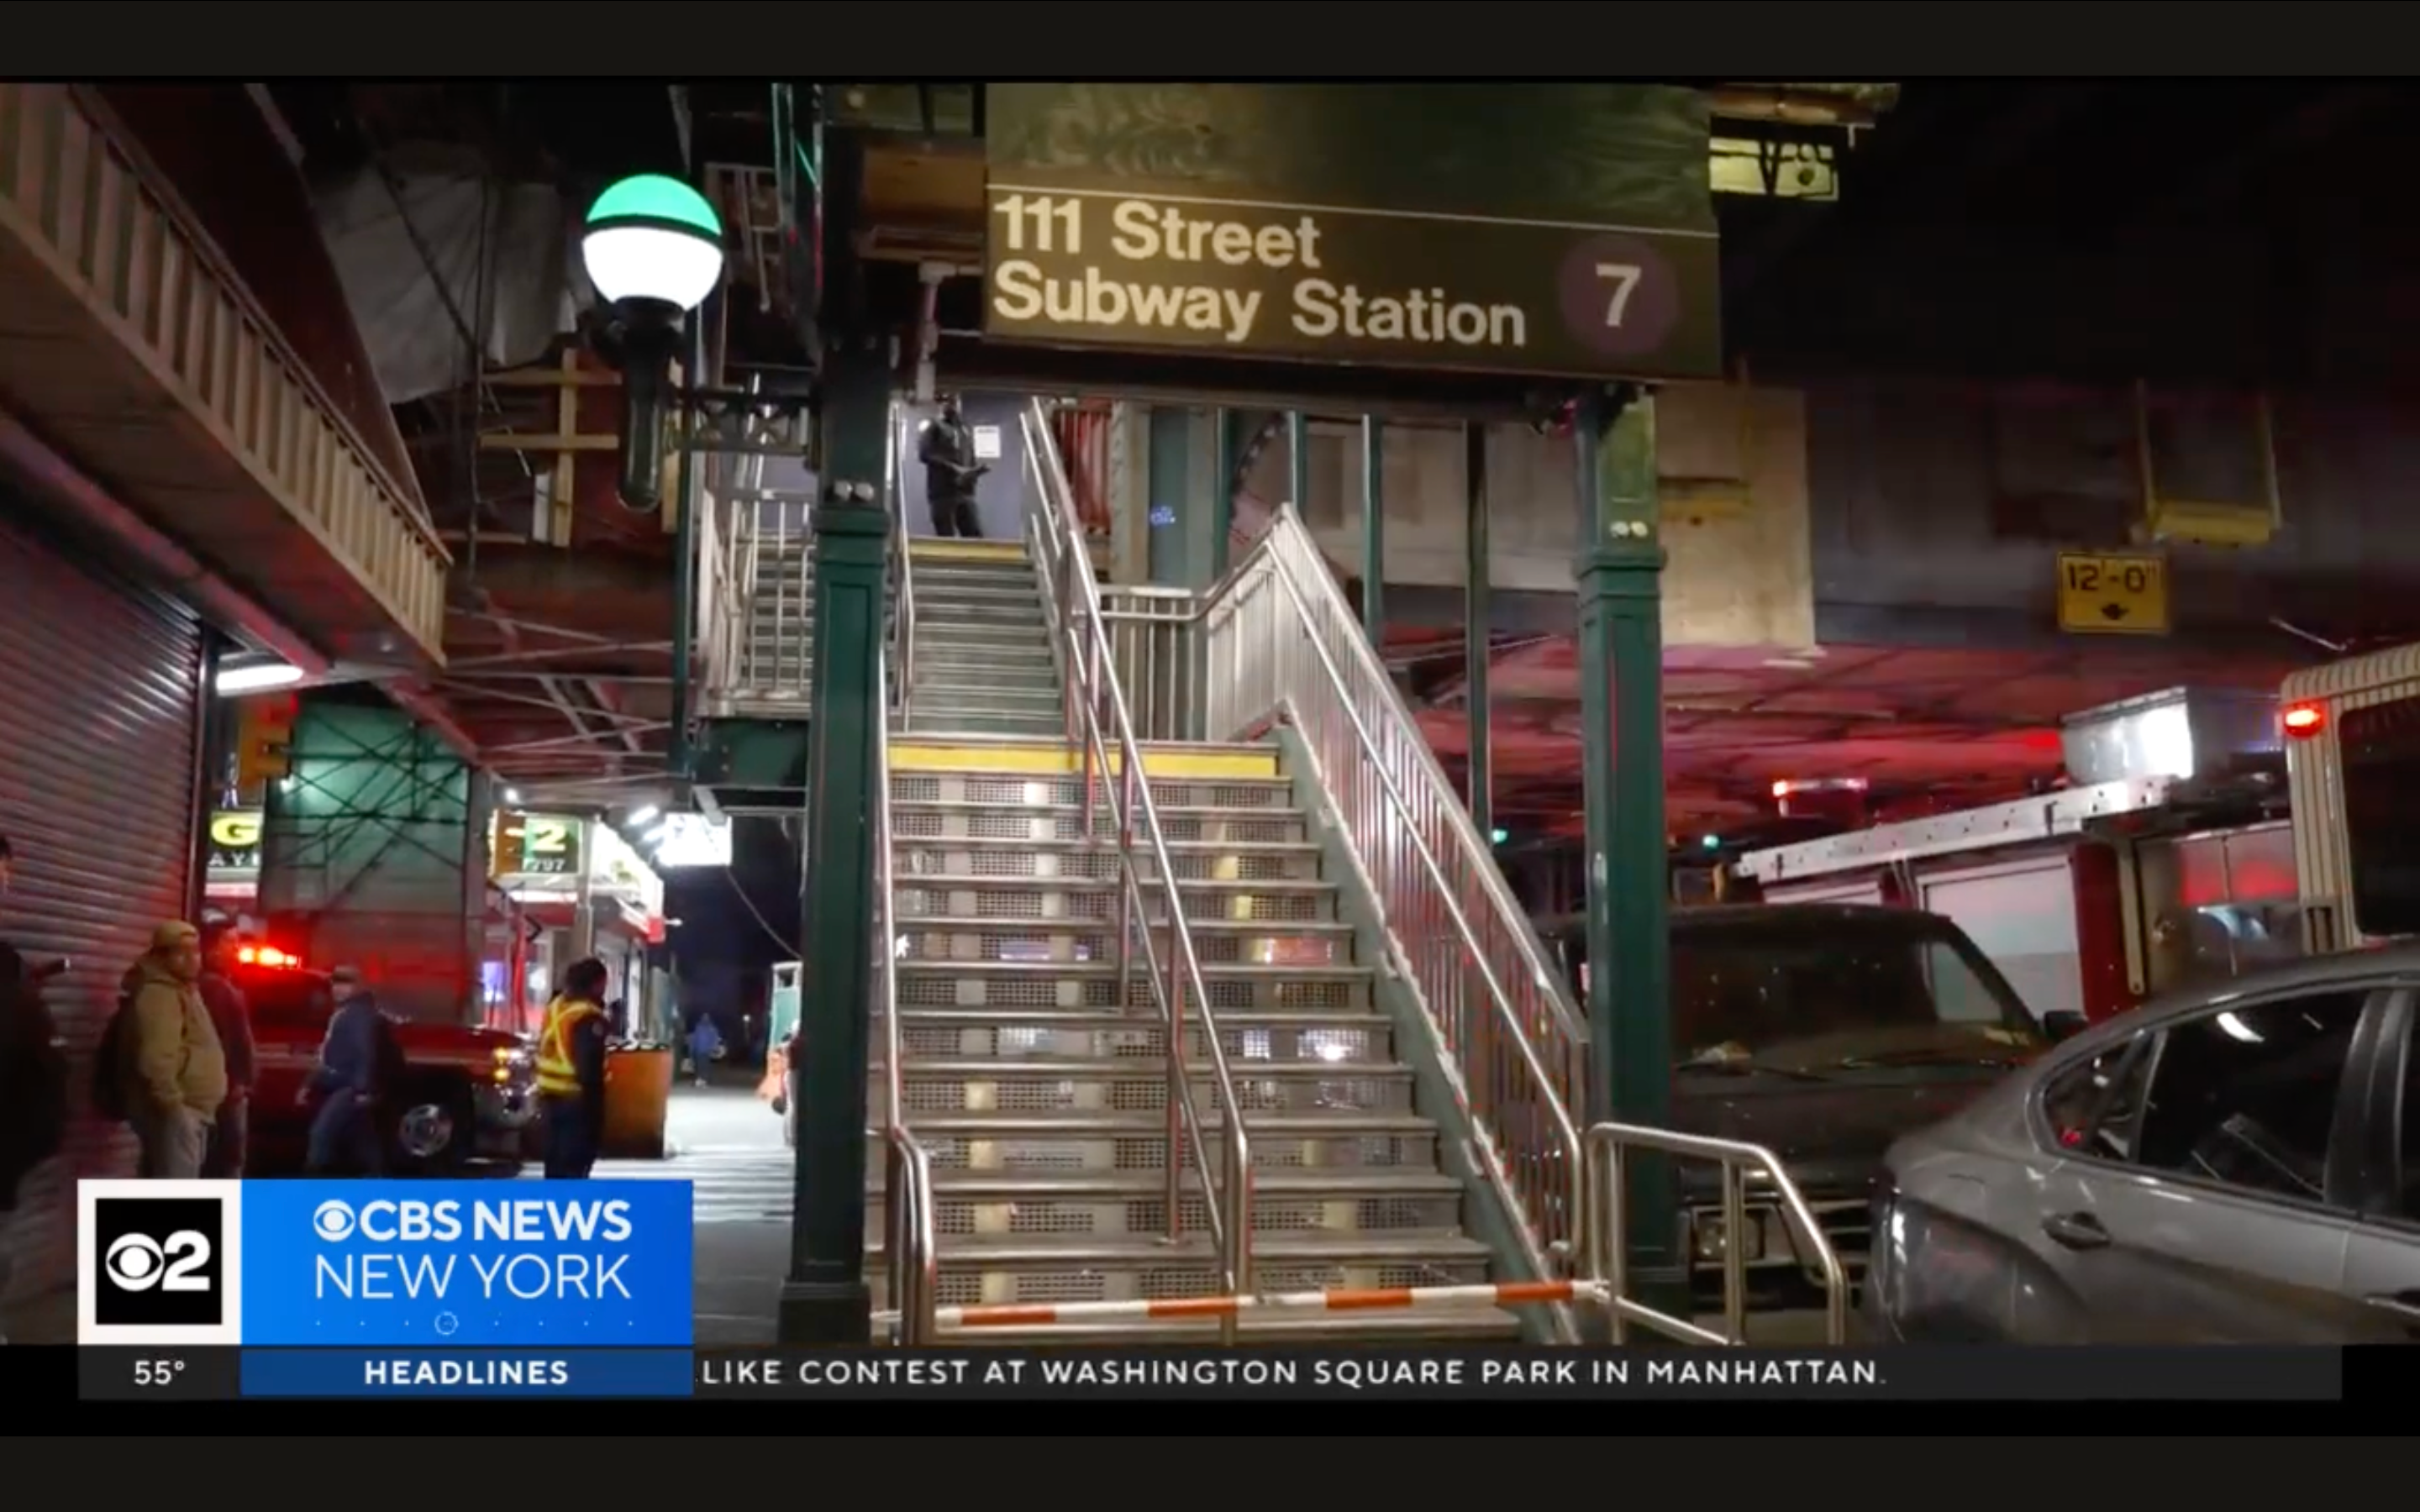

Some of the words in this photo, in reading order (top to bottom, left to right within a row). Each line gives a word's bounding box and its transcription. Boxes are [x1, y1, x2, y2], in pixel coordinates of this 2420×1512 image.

[994, 195, 1081, 253] 111
[1111, 201, 1321, 268] Street
[993, 260, 1262, 342] Subway
[1292, 278, 1526, 346] Station
[1596, 263, 1642, 327] 7
